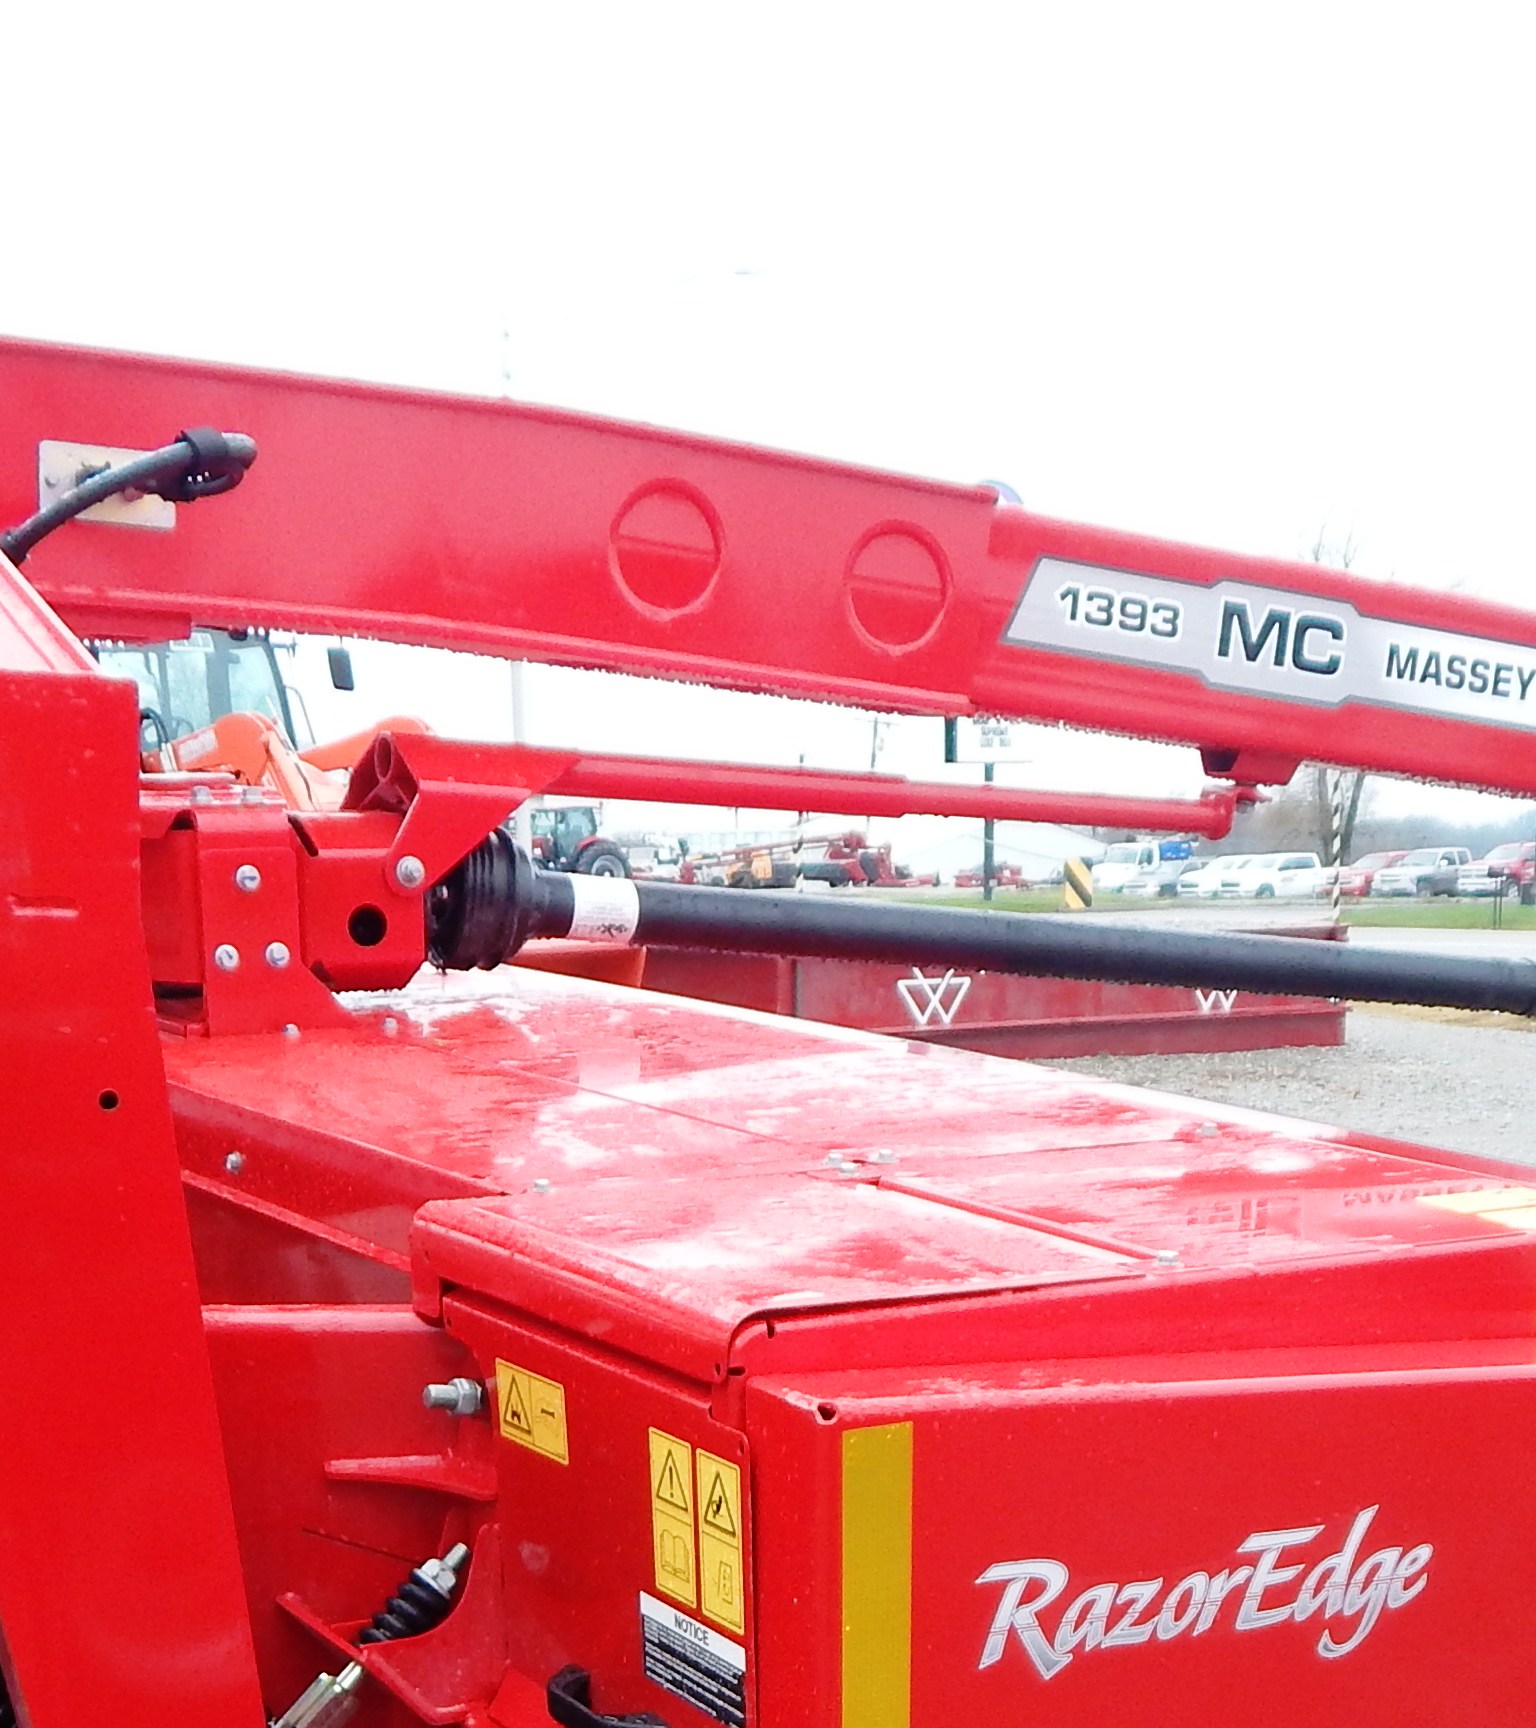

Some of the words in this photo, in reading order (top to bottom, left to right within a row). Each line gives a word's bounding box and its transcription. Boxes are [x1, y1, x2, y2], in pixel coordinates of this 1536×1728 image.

[1058, 585, 1180, 637] 1393
[1215, 599, 1347, 677] MC
[1383, 642, 1536, 707] MASSEY
[674, 1615, 710, 1646] NOTICE
[975, 1503, 1435, 1680] RazorEdge
